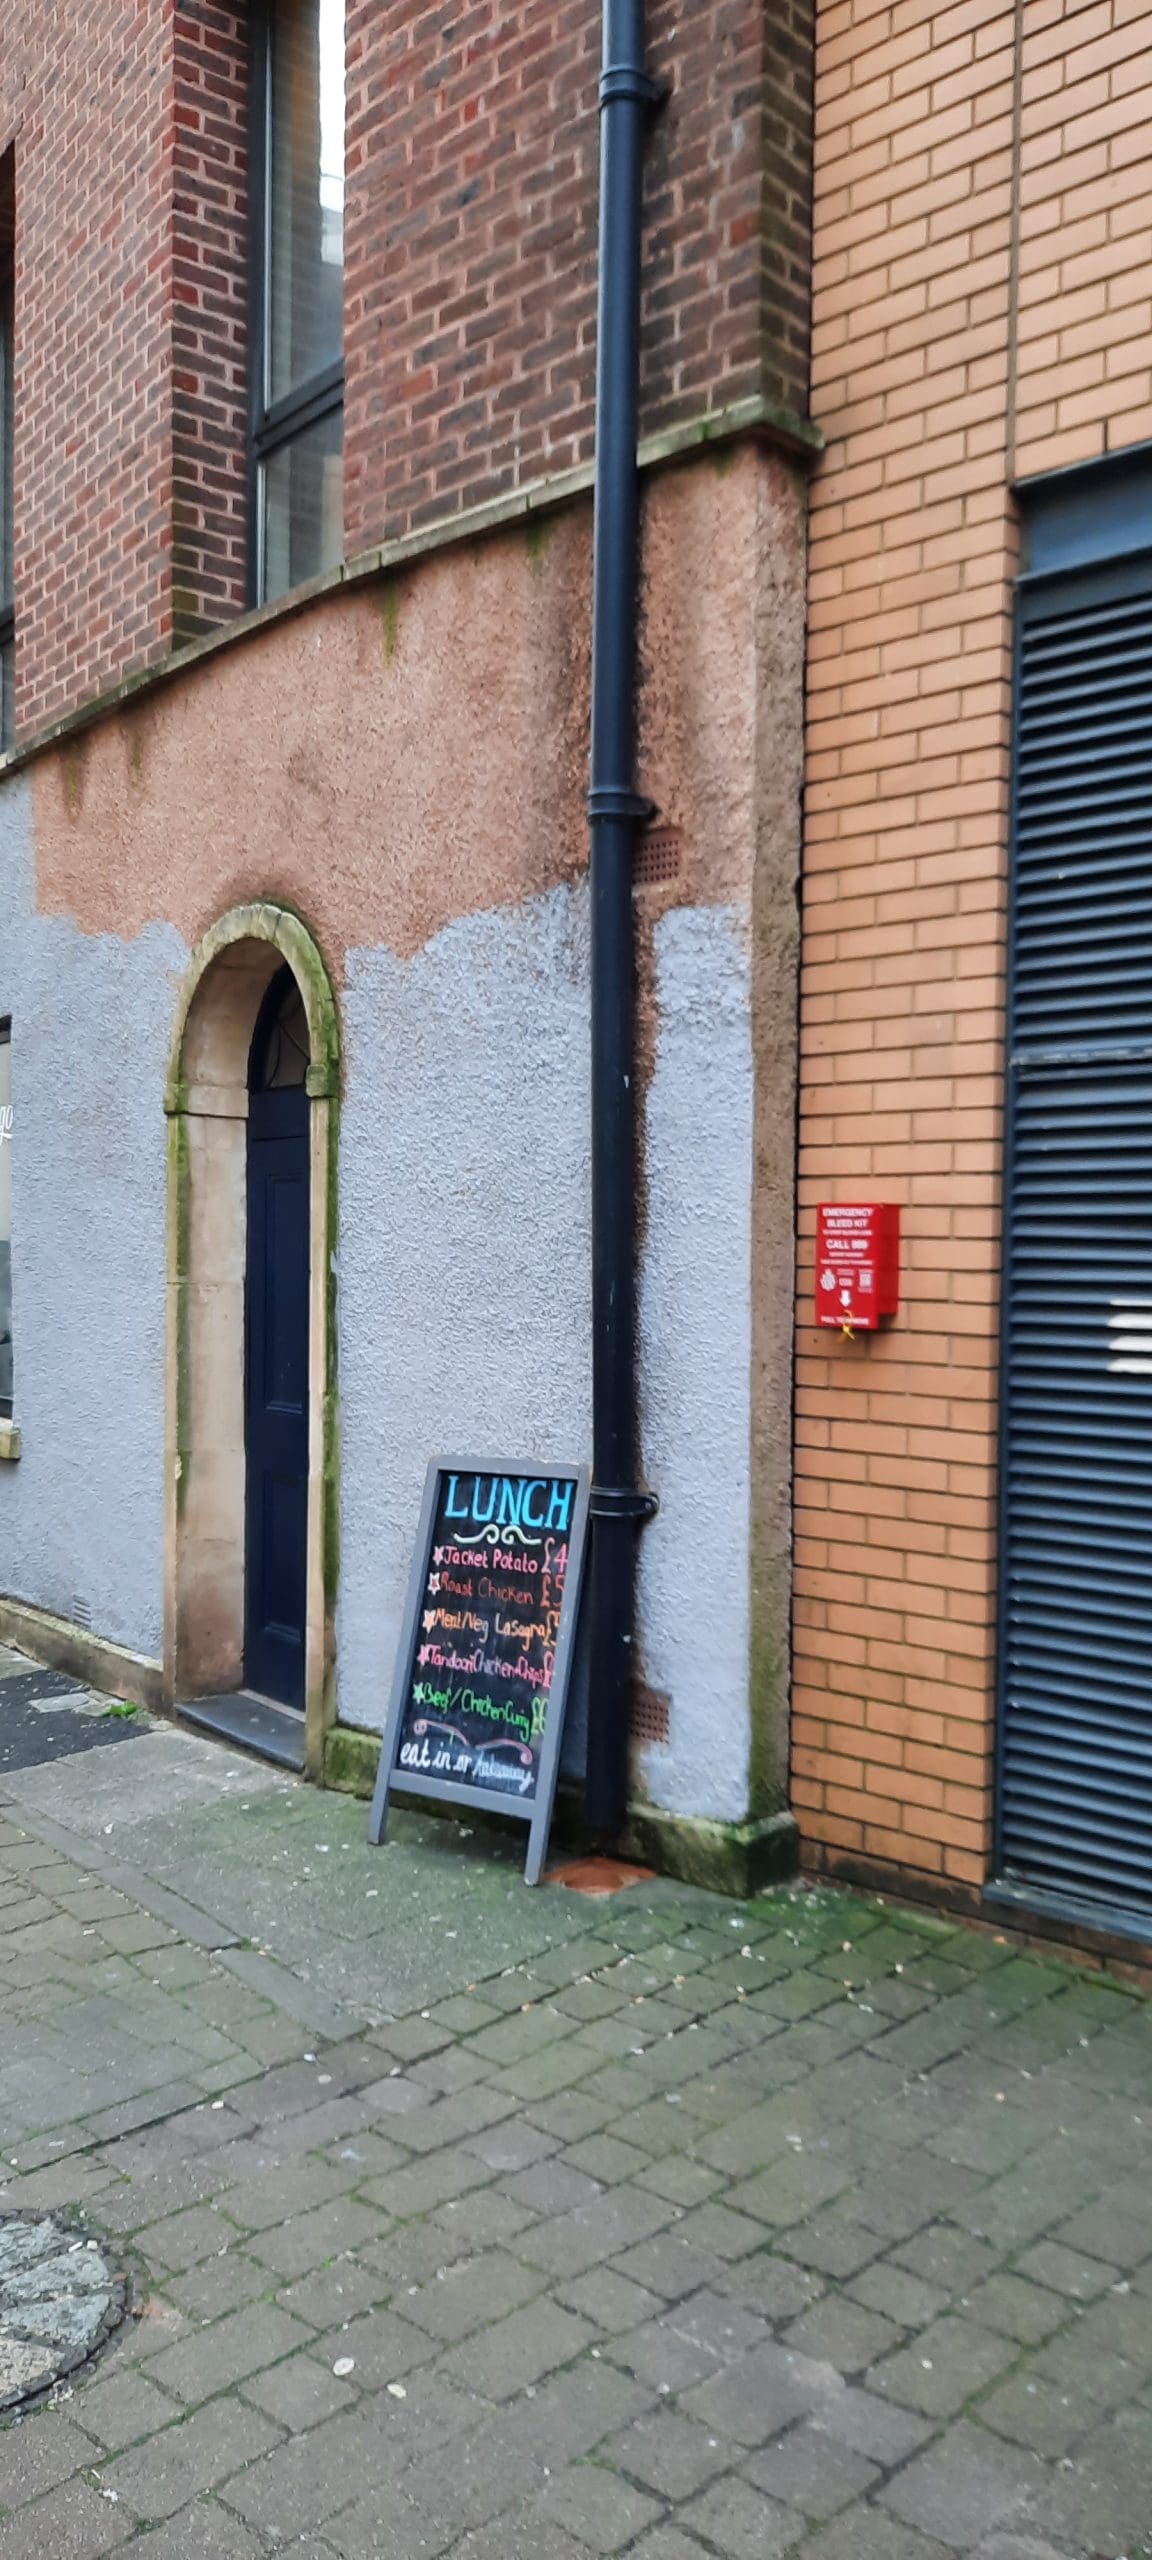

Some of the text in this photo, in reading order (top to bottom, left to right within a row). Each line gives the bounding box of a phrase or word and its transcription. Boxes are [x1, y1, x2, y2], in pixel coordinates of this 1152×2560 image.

[826, 1239, 850, 1250] CALL
[445, 1475, 574, 1531] LUNCH
[443, 1546, 489, 1569] Jacket
[492, 1548, 538, 1574] Potato
[478, 1577, 533, 1605] Chicken
[400, 1738, 431, 1768] eat
[431, 1741, 451, 1770] in
